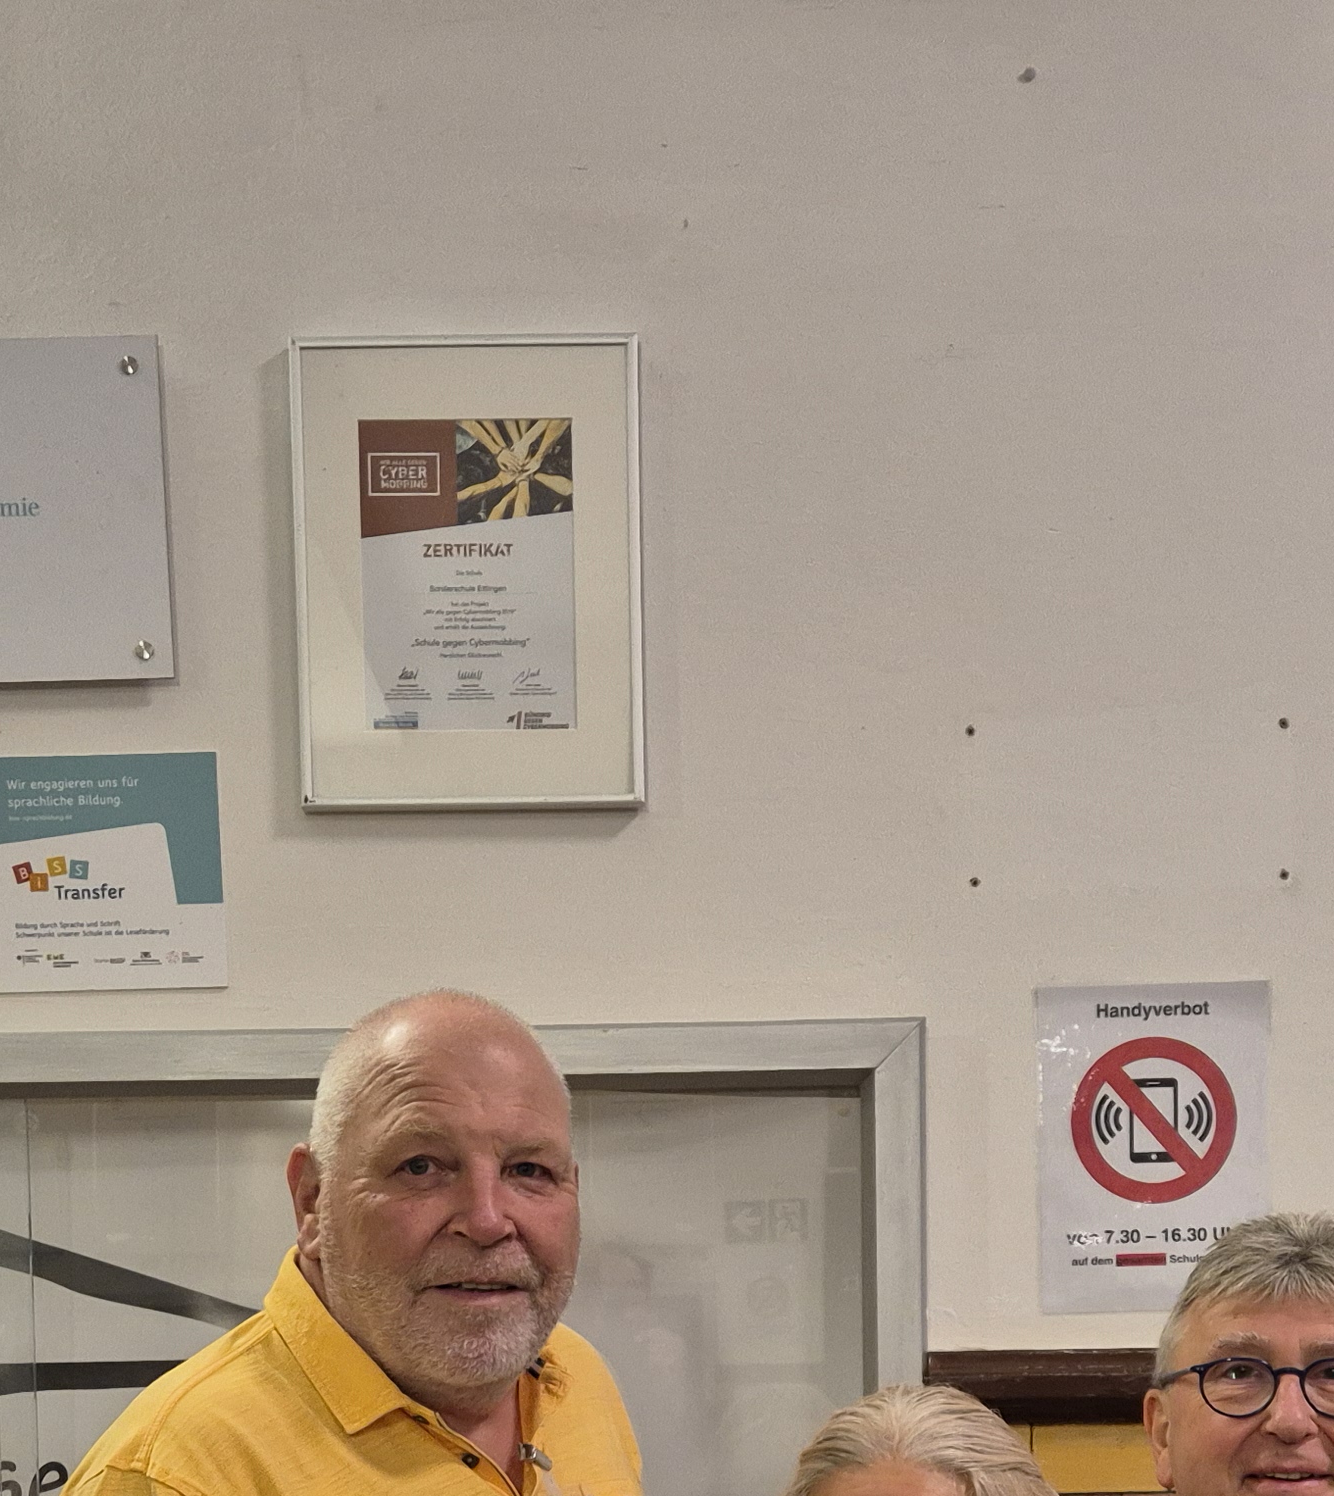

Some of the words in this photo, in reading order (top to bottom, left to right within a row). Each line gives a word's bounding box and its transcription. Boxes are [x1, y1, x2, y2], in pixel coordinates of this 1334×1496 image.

[379, 466, 428, 479] CYBER
[422, 543, 514, 558] ZERTIFIKAT
[442, 640, 467, 649] gegen
[6, 779, 27, 790] Wir
[30, 779, 94, 792] engagieren
[97, 778, 118, 789] uns
[122, 776, 139, 788] für
[8, 795, 74, 811] sprachliche
[78, 794, 124, 808] Bildung.
[54, 883, 125, 901] Transfer
[59, 921, 85, 930] Sprache
[82, 929, 103, 937] Schule
[1096, 1001, 1210, 1021] Handyverbot
[1104, 1229, 1141, 1245] 7.30
[1161, 1227, 1208, 1243] 16.30
[1071, 1256, 1089, 1267] auf
[1091, 1255, 1114, 1266] dem
